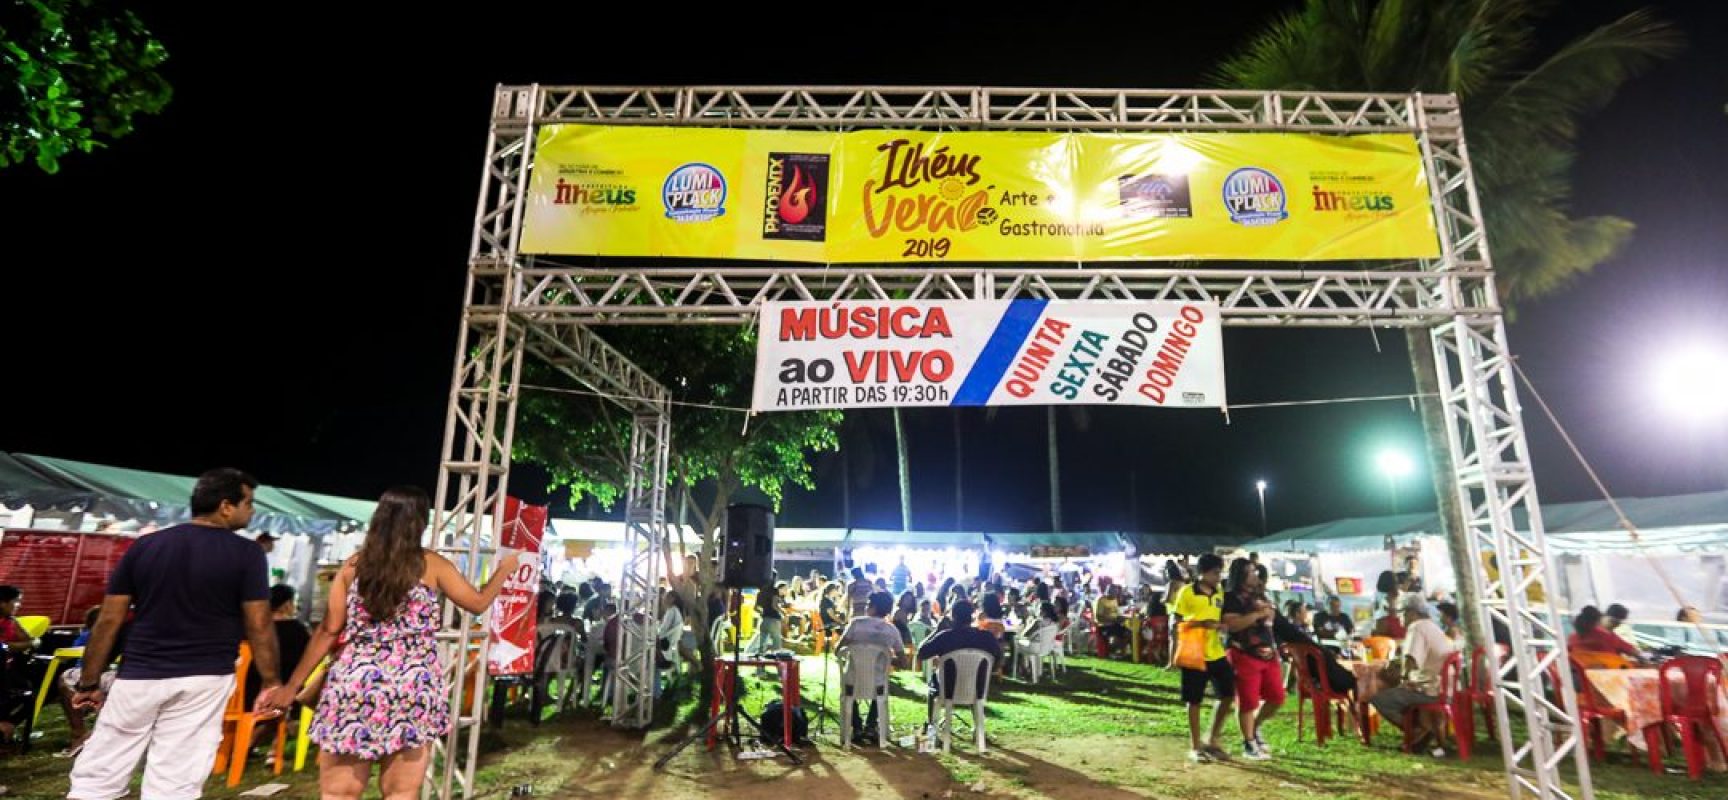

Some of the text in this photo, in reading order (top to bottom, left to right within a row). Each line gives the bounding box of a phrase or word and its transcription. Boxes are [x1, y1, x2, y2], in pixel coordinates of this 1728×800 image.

[671, 172, 713, 191] LUMI
[875, 138, 982, 194] Ilhéus
[667, 189, 721, 208] PLACK
[765, 158, 784, 233] PHOENIX
[999, 189, 1038, 206] Arte
[1230, 194, 1280, 211] PLACK
[1231, 176, 1270, 195] LUMI
[902, 237, 951, 257] 2019
[779, 302, 953, 341] MÚSICA
[778, 349, 954, 384] ao VIVO
[1006, 317, 1071, 398] QUINTA
[1050, 329, 1110, 400] SEXTA
[1093, 311, 1158, 402] SÁBADO
[1138, 305, 1204, 404] DOMINGO
[776, 388, 788, 406] A
[791, 387, 848, 405] PARTIR
[855, 385, 887, 403] DAS
